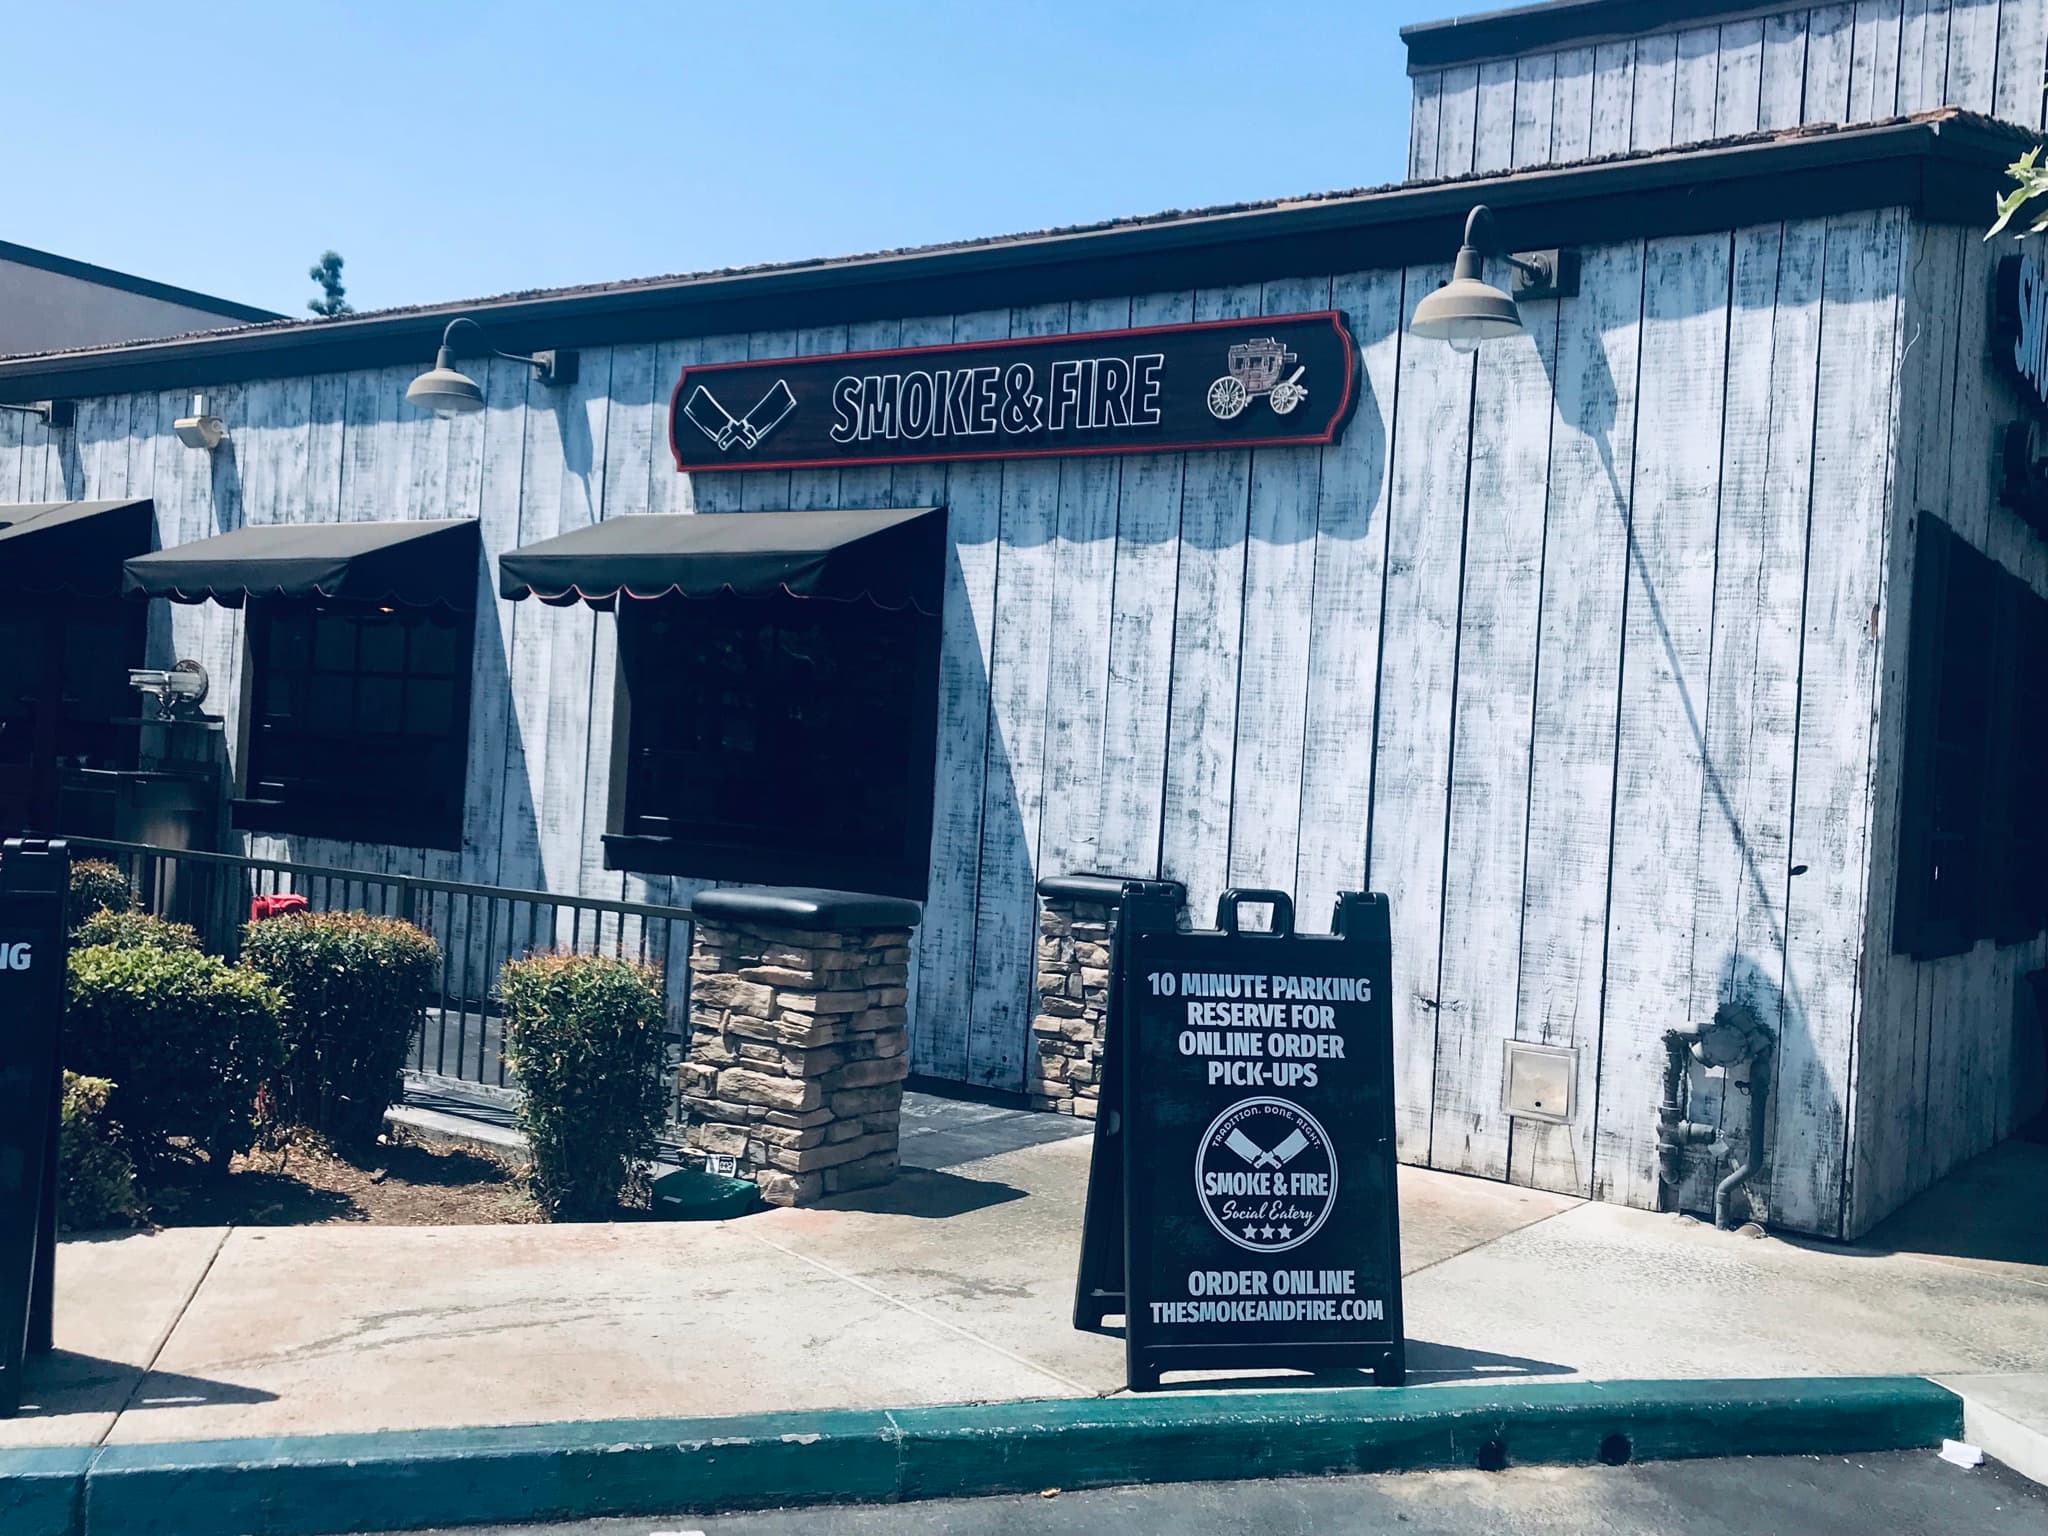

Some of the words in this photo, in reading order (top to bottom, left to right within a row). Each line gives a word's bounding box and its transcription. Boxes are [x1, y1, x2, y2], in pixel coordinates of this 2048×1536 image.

[830, 366, 1000, 443] SMOKE
[1048, 353, 1164, 430] FIRE
[1147, 972, 1176, 996] 10
[1181, 973, 1268, 998] MINUTE
[1272, 975, 1371, 1001] PARKING
[1187, 1002, 1287, 1028] RESERVE
[1291, 1005, 1336, 1029] FOR
[1178, 1031, 1263, 1056] ONLINE
[1267, 1034, 1345, 1059] ORDER
[1208, 1061, 1318, 1088] PICK-UPS
[1205, 1172, 1271, 1196] SMOKE
[1273, 1172, 1288, 1196] &
[1291, 1173, 1329, 1196] FIRE
[1221, 1200, 1268, 1221] Social
[1269, 1200, 1315, 1227] Eatery
[1188, 1270, 1268, 1296] ORDER
[1273, 1270, 1355, 1295] ONLINE
[1150, 1300, 1384, 1323] THESMOKEANDFIRE.COM
